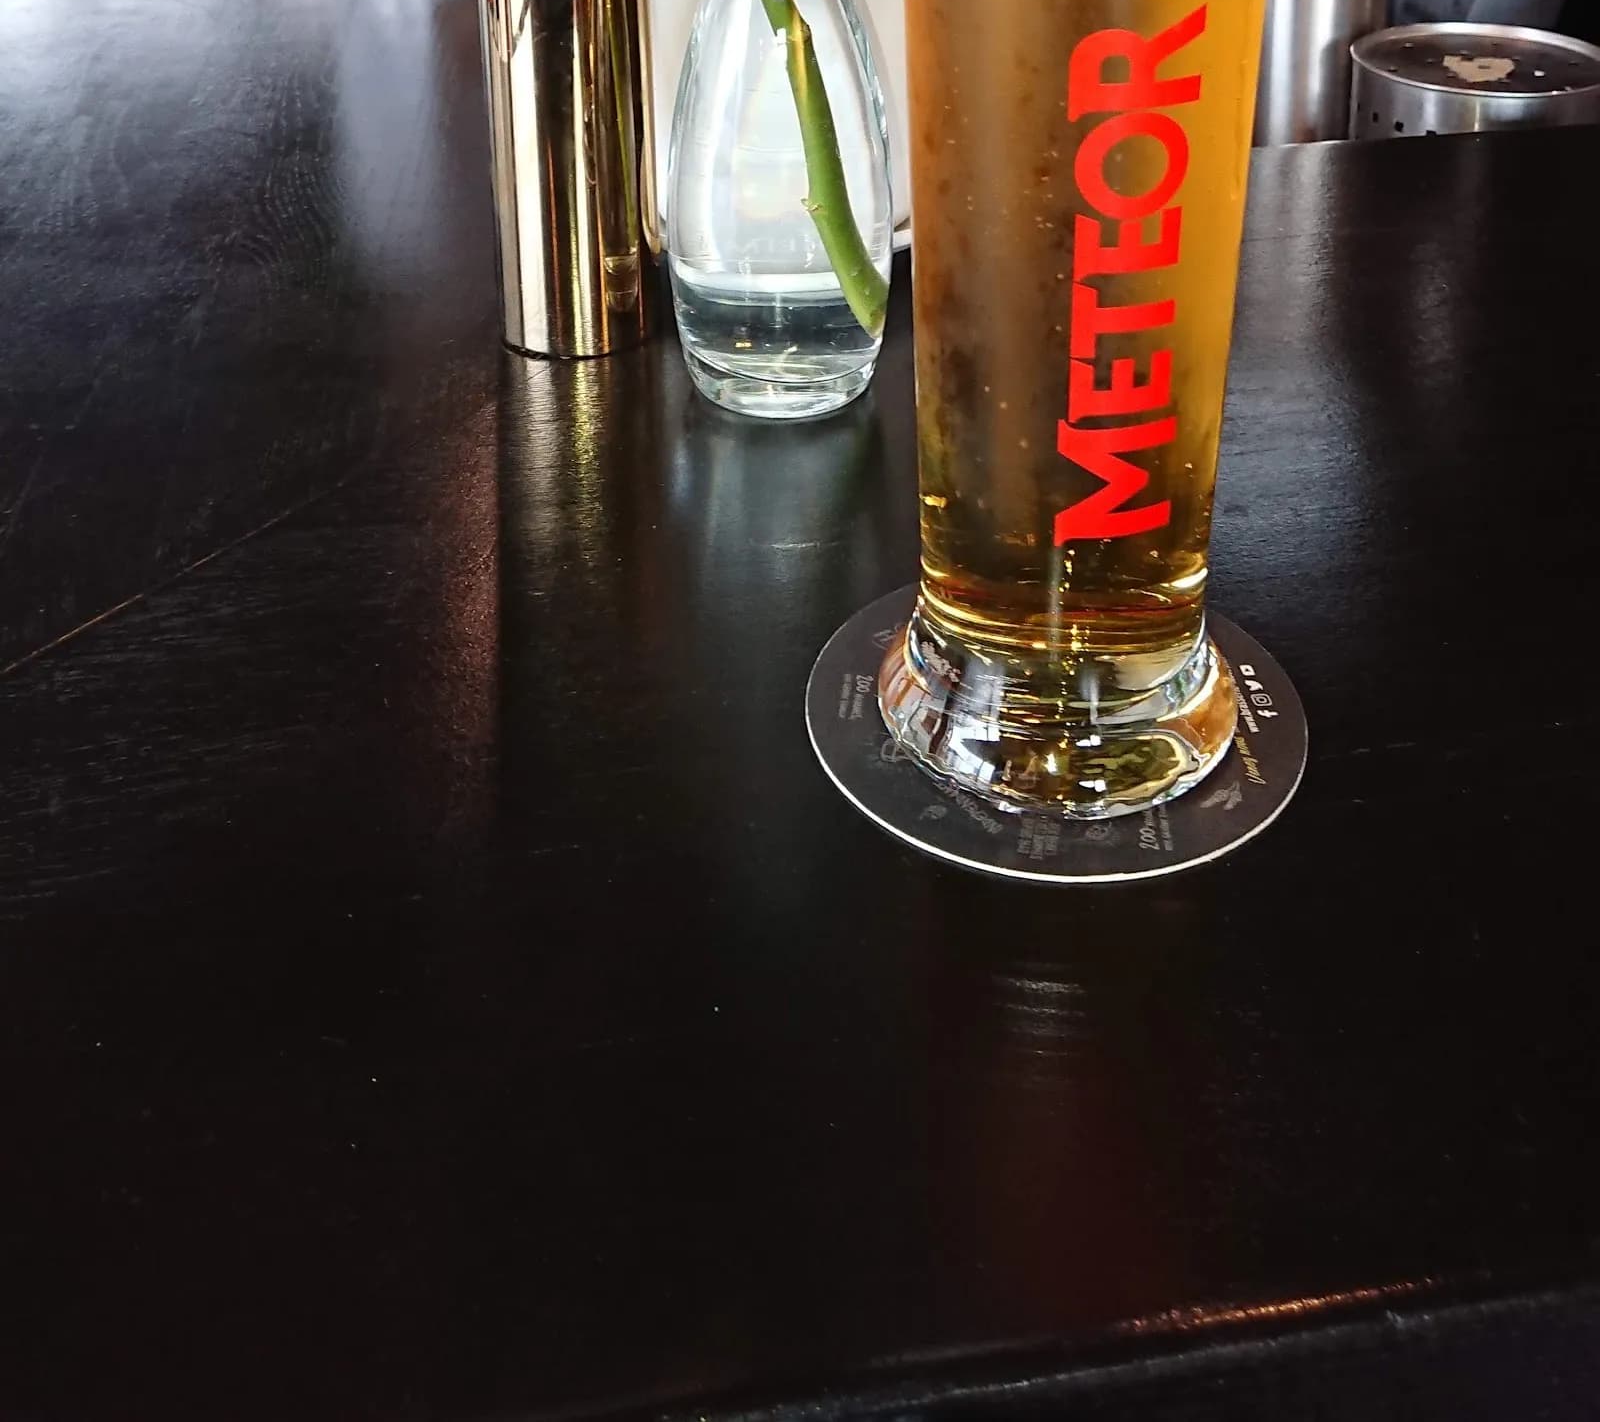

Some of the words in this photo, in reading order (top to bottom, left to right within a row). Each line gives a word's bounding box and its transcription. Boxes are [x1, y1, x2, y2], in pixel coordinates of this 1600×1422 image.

[1054, 4, 1207, 546] METEOR
[855, 674, 874, 693] 200
[1139, 827, 1160, 850] 200
